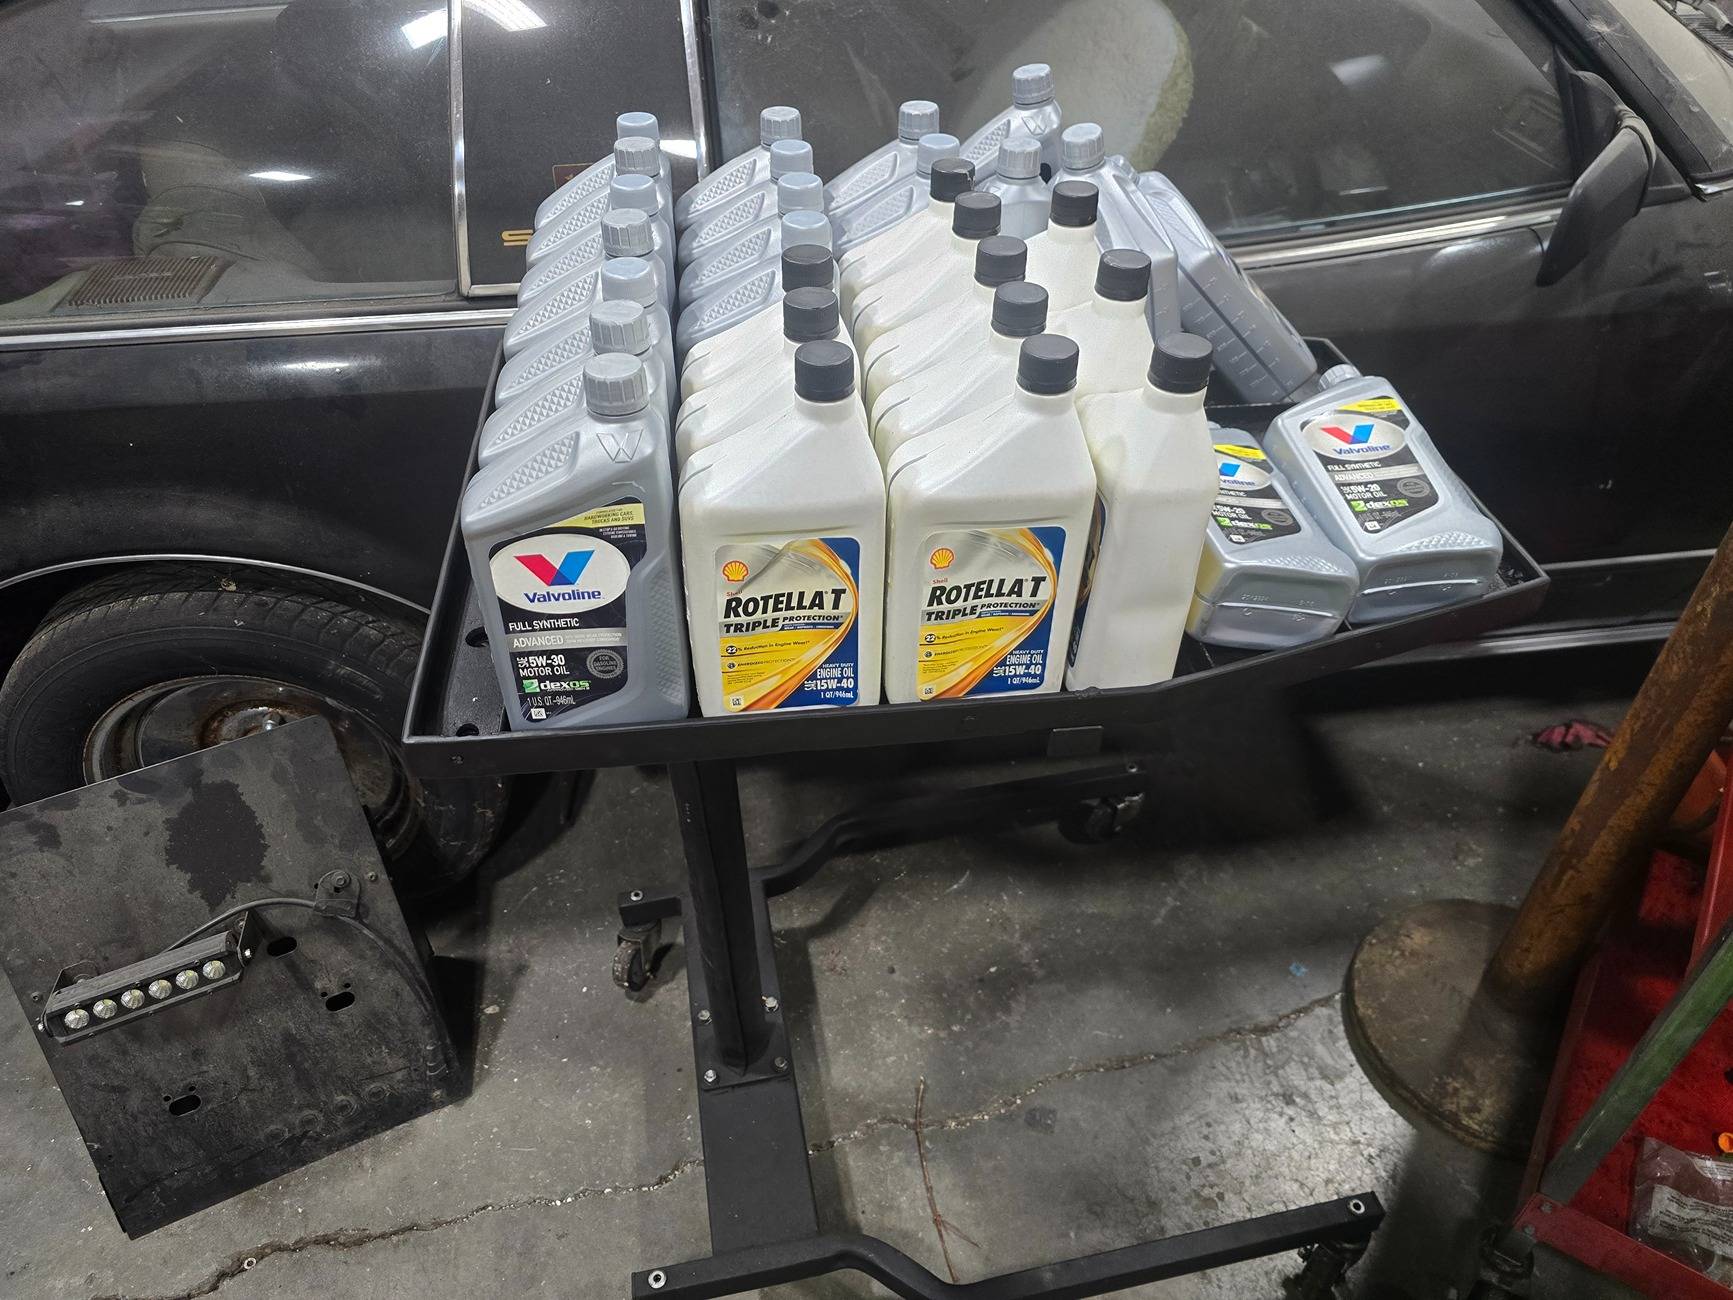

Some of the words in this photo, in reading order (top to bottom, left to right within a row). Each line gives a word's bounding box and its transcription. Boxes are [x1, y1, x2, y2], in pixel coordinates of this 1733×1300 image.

[1333, 444, 1391, 456] Valvoline
[1334, 472, 1374, 482] ADVANCED
[1345, 492, 1373, 500] MOTOR
[1374, 490, 1388, 498] OIL
[1029, 576, 1048, 598] T
[524, 588, 602, 603] Valvoline
[831, 588, 847, 610] T
[925, 604, 979, 622] TRIPLE
[508, 621, 532, 631] FULL
[533, 618, 580, 629] SYNTHETIC
[723, 617, 780, 634] TRIPLE
[513, 635, 564, 648] ADVANCED
[528, 654, 566, 667] 5W-30
[1006, 655, 1031, 665] ENGINE
[1031, 654, 1043, 663] OIL
[520, 666, 553, 677] MOTOR
[554, 666, 570, 675] OIL
[816, 668, 842, 679] ENGINE
[842, 667, 854, 677] OIL
[1004, 664, 1042, 676] 15W-40
[540, 680, 591, 690] dexos
[817, 678, 854, 690] 15W-40
[527, 697, 532, 706] 1
